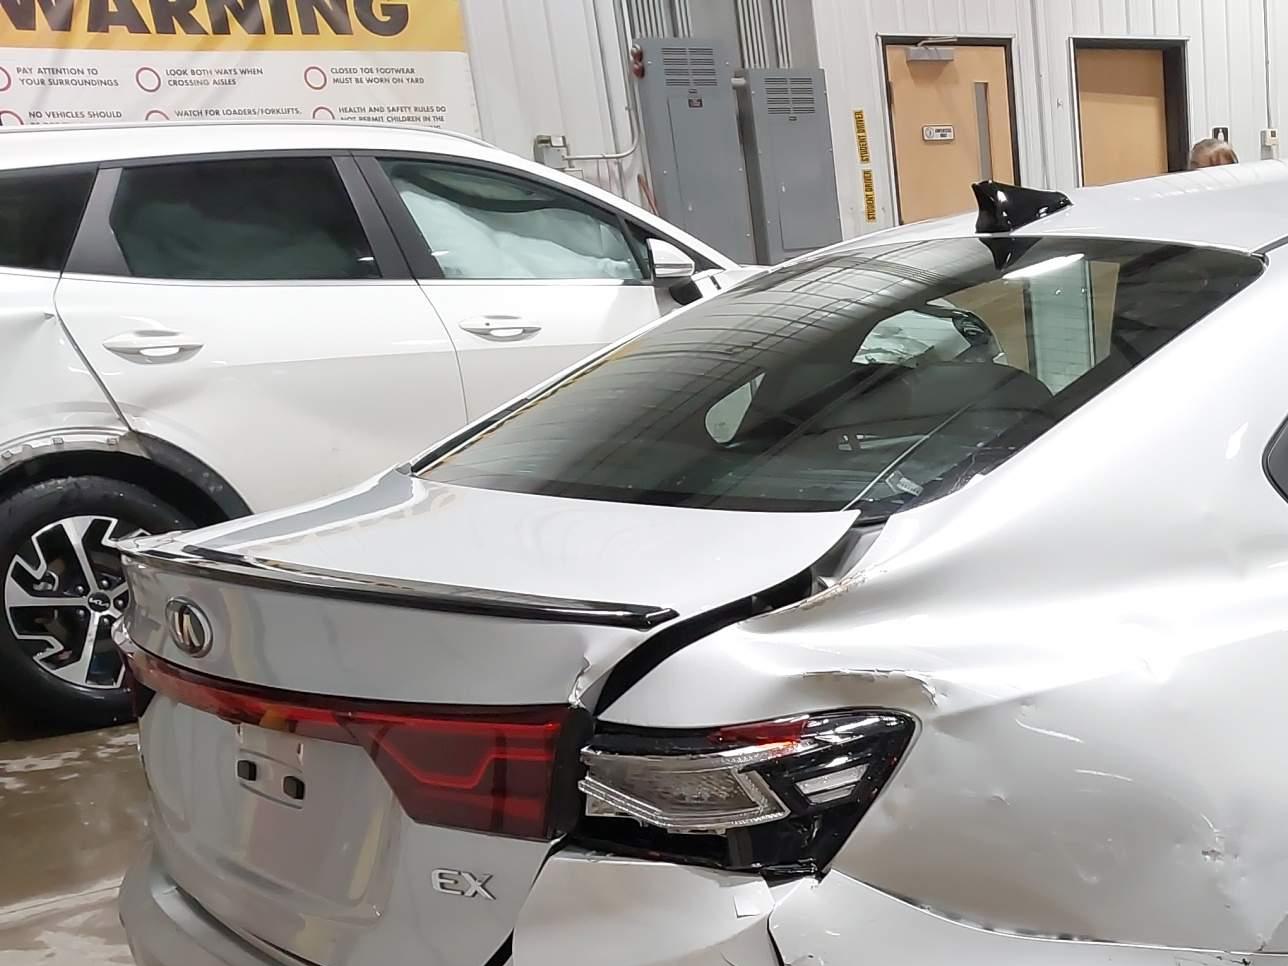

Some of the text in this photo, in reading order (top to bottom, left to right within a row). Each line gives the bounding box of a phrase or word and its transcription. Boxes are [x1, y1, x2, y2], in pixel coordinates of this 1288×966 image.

[0, 0, 409, 36] WARNING
[16, 67, 33, 75] PAY
[37, 67, 85, 75] ATTENTION
[20, 78, 119, 87] YOUR SURROUNDINGS
[29, 111, 42, 119] NO
[45, 111, 85, 119] VEHICLES
[854, 111, 870, 163] STUDENT DRIVER
[863, 170, 876, 221] STUDENT DRIVER
[431, 868, 497, 901] EX
